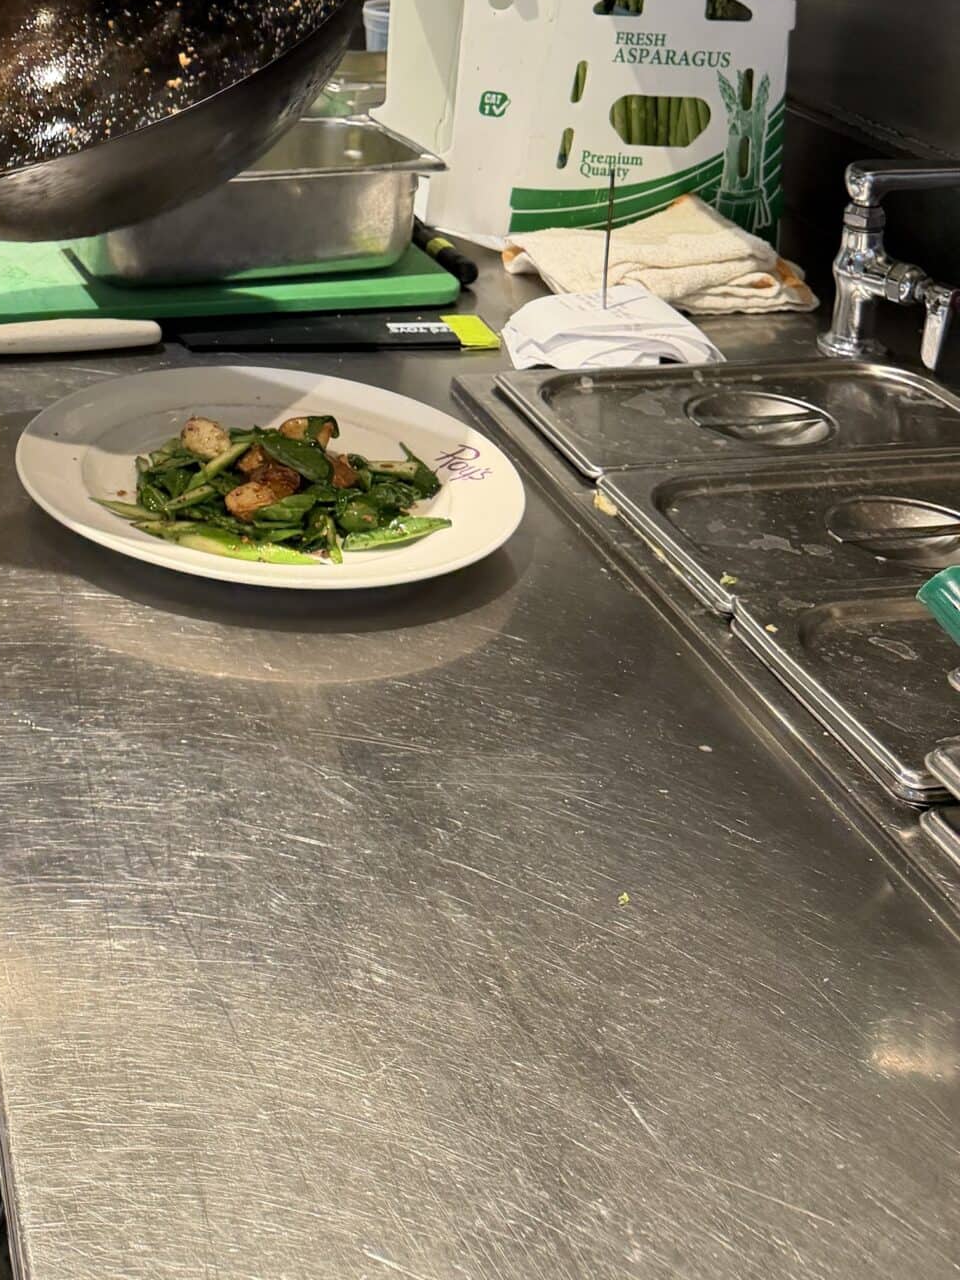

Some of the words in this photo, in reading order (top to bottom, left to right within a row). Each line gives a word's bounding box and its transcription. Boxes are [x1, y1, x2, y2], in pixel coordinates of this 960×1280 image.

[615, 31, 667, 47] FRESH
[612, 47, 732, 68] ASPARAGUS
[582, 150, 643, 166] Premium
